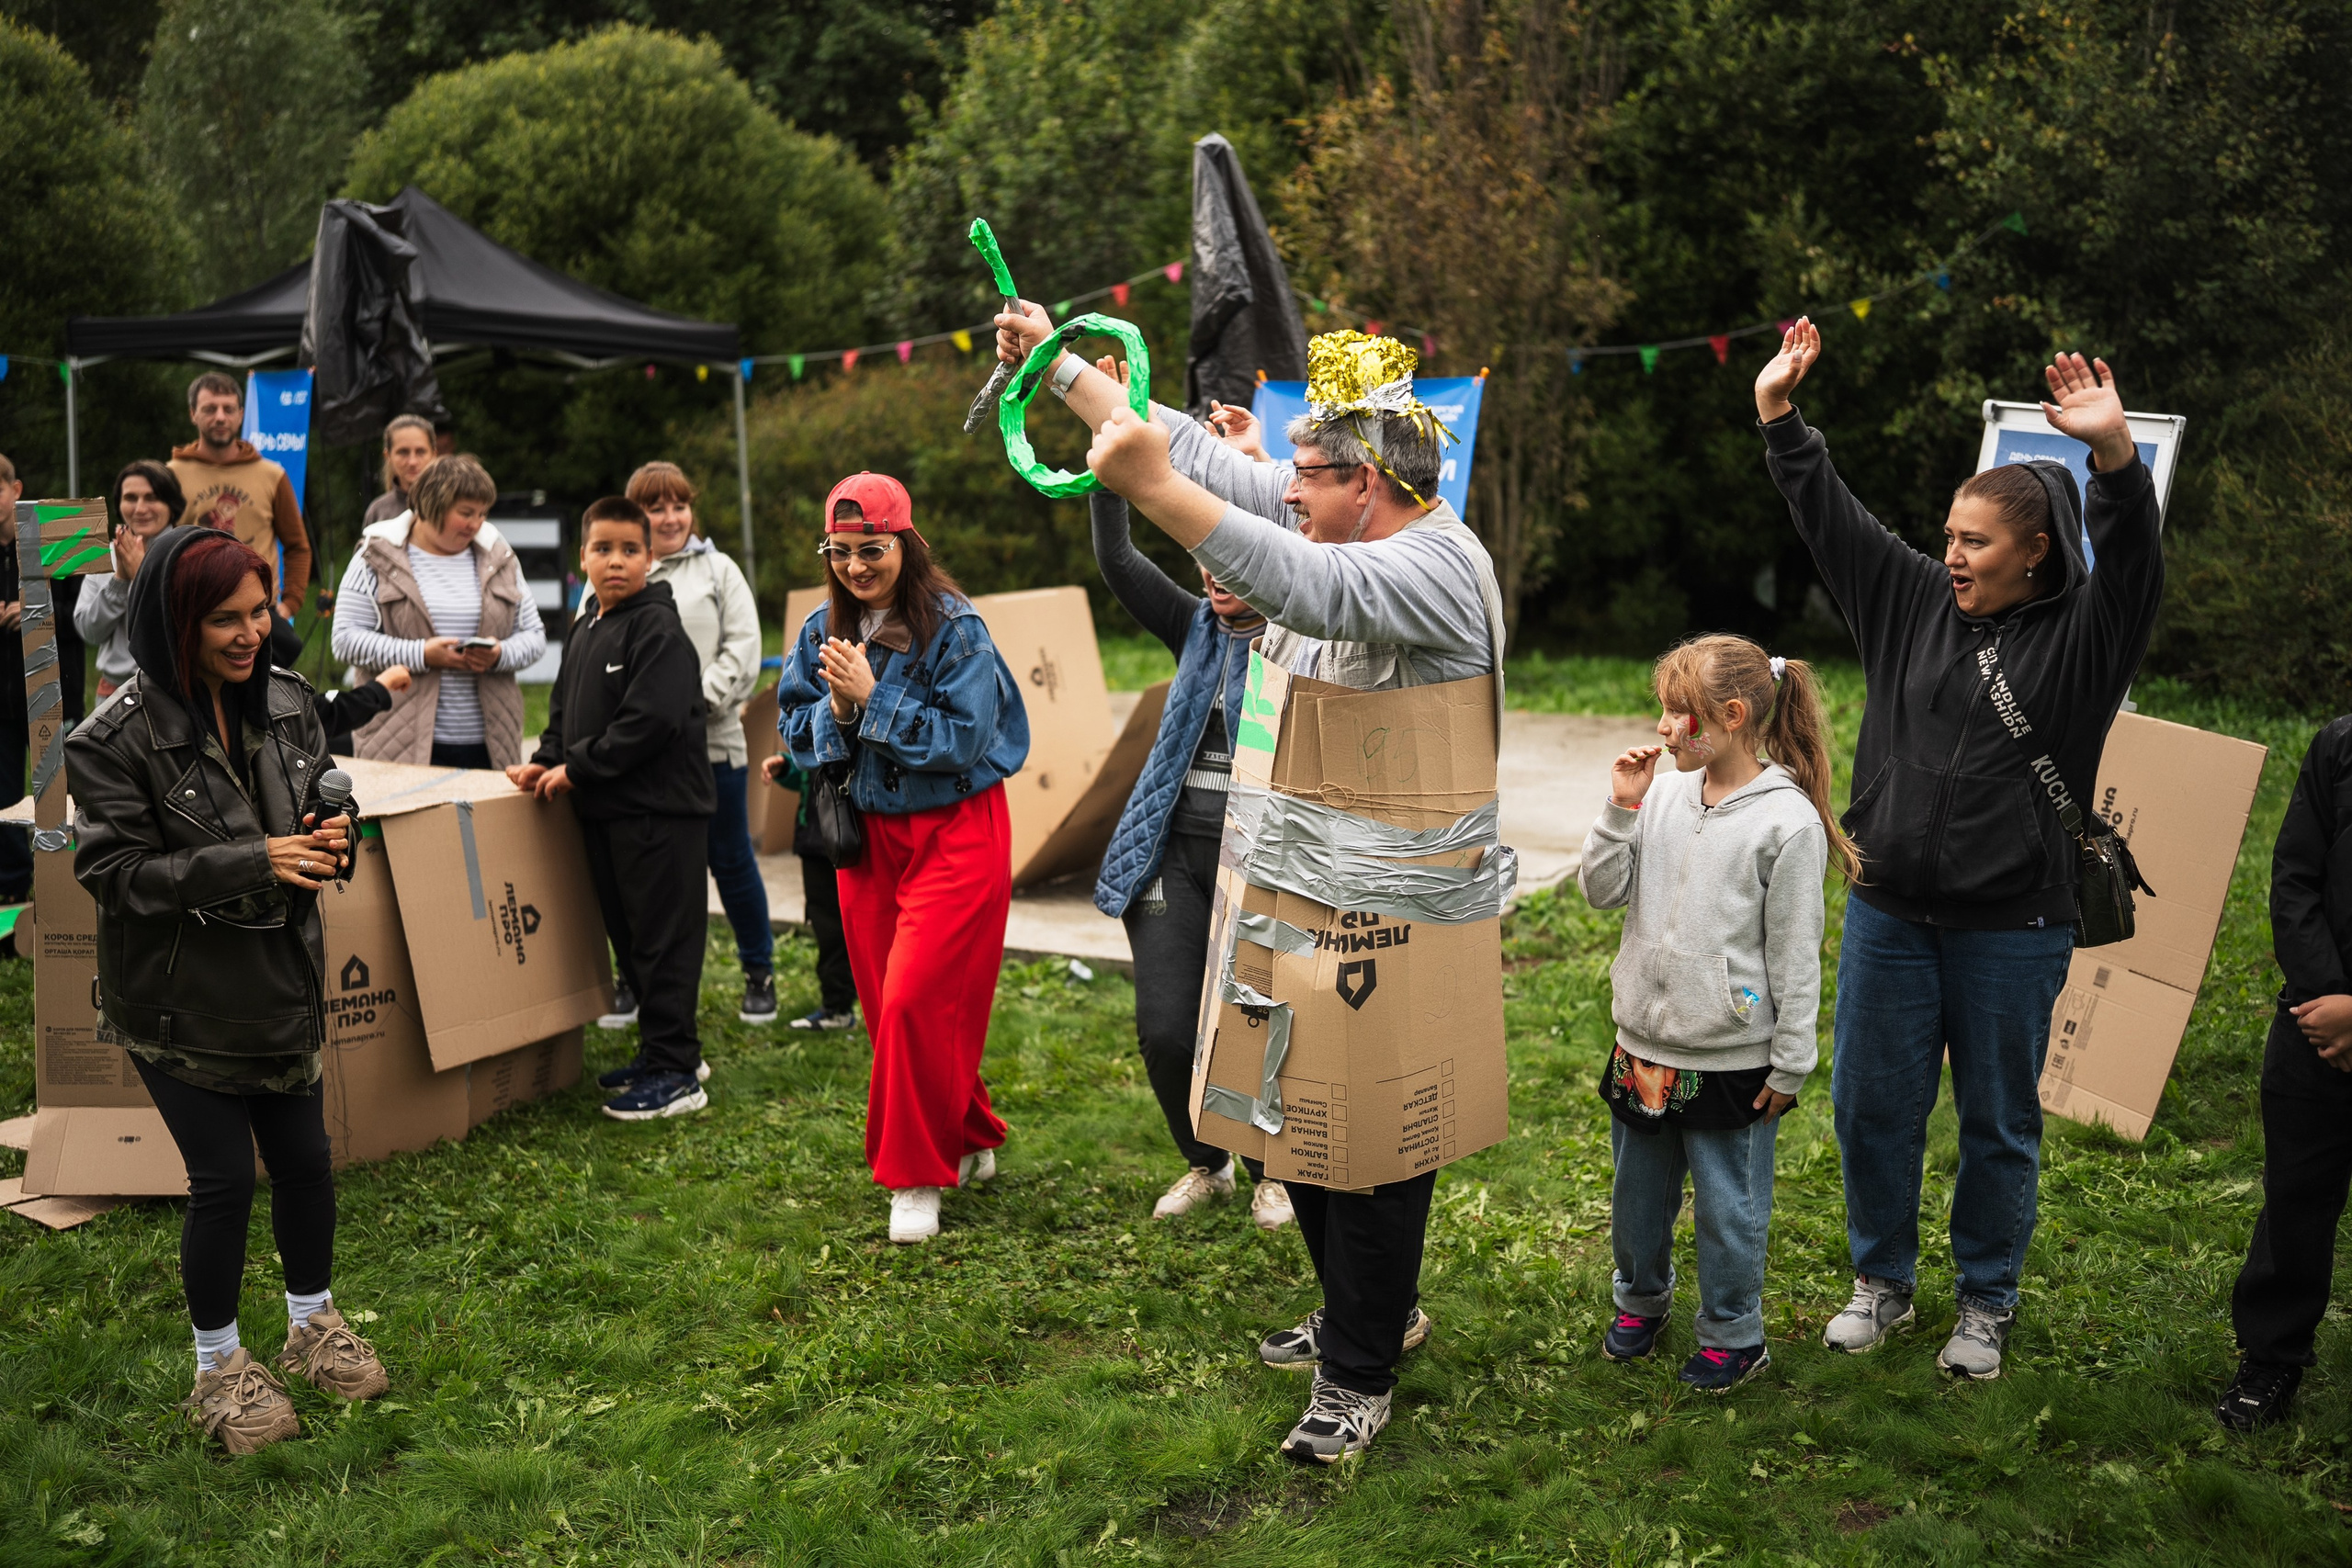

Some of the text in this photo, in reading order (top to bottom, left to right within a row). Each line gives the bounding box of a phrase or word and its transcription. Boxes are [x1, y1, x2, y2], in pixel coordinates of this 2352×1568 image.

[499, 905, 513, 946] ПРО
[504, 882, 526, 966] ЛЕМАНА
[1340, 911, 1380, 930] ПР
[44, 933, 98, 942] КОРОБ СРЕД
[338, 1009, 377, 1029] ПРО
[1403, 1091, 1438, 1111] ДЕТСКАЯ
[1285, 1104, 1328, 1118] ХРУПКОЕ
[1402, 1114, 1439, 1133] СПАЛЬНЯ
[1291, 1125, 1328, 1138] ВАННАЯ
[1303, 1140, 1329, 1150] Балкон
[1397, 1134, 1440, 1155] ГОСТИНАЯ
[1291, 1147, 1329, 1160] БАЛКОН
[1306, 1161, 1329, 1171] Гараж
[1414, 1154, 1440, 1169] КУХНЯ
[1296, 1168, 1329, 1180] ГАРАЖ
